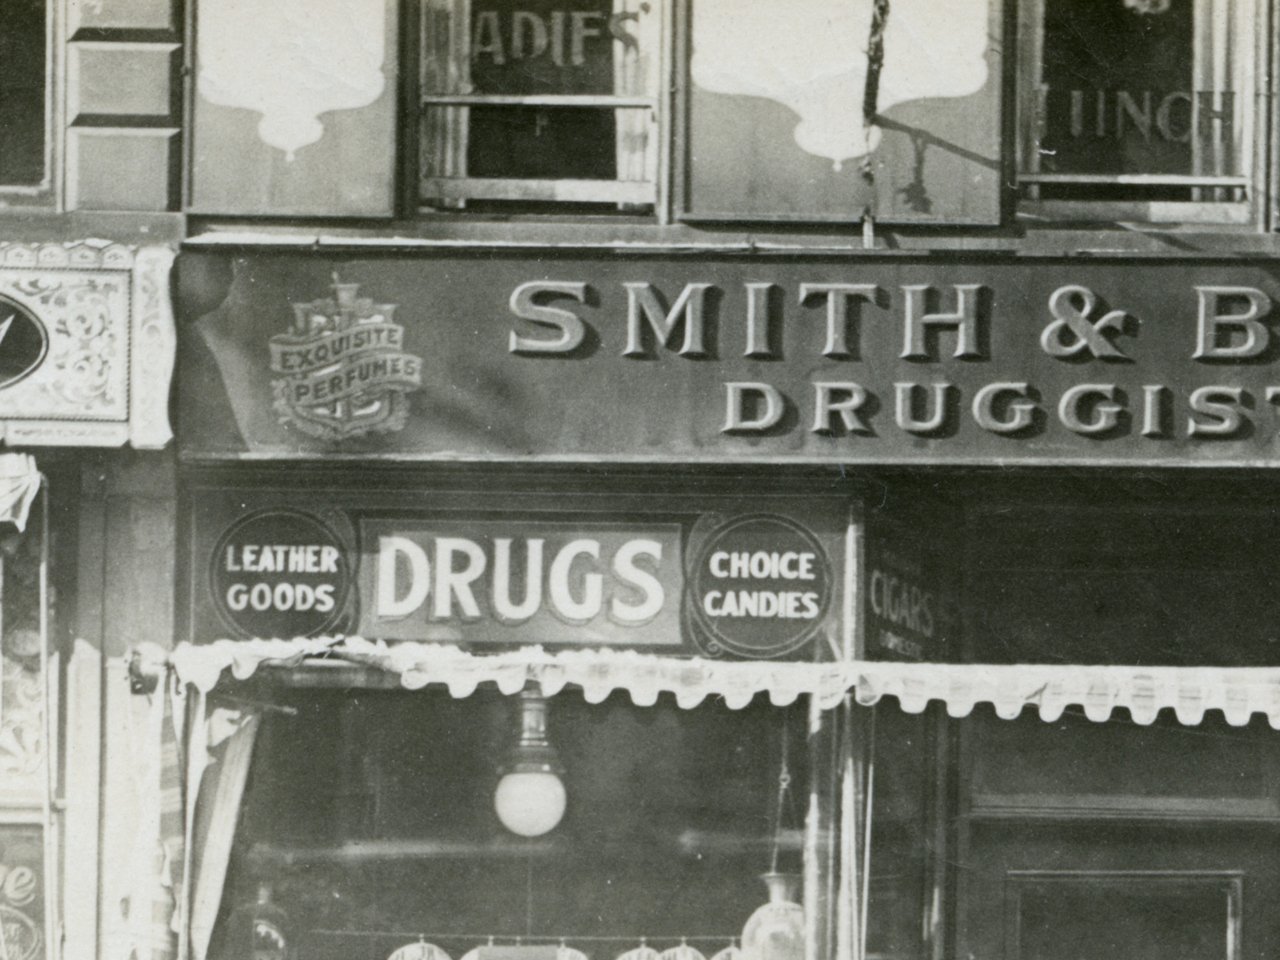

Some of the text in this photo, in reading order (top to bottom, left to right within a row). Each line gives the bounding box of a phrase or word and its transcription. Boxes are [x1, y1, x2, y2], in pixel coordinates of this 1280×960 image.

[508, 281, 990, 358] SMITH
[1040, 285, 1131, 359] &
[280, 328, 398, 370] EXQUISITE
[295, 358, 417, 401] PERFUMES
[226, 545, 339, 574] LEATHER
[708, 551, 815, 580] CHOICE
[377, 536, 665, 622] DRUGS
[226, 583, 335, 612] GOODS
[703, 592, 820, 619] CANDIES
